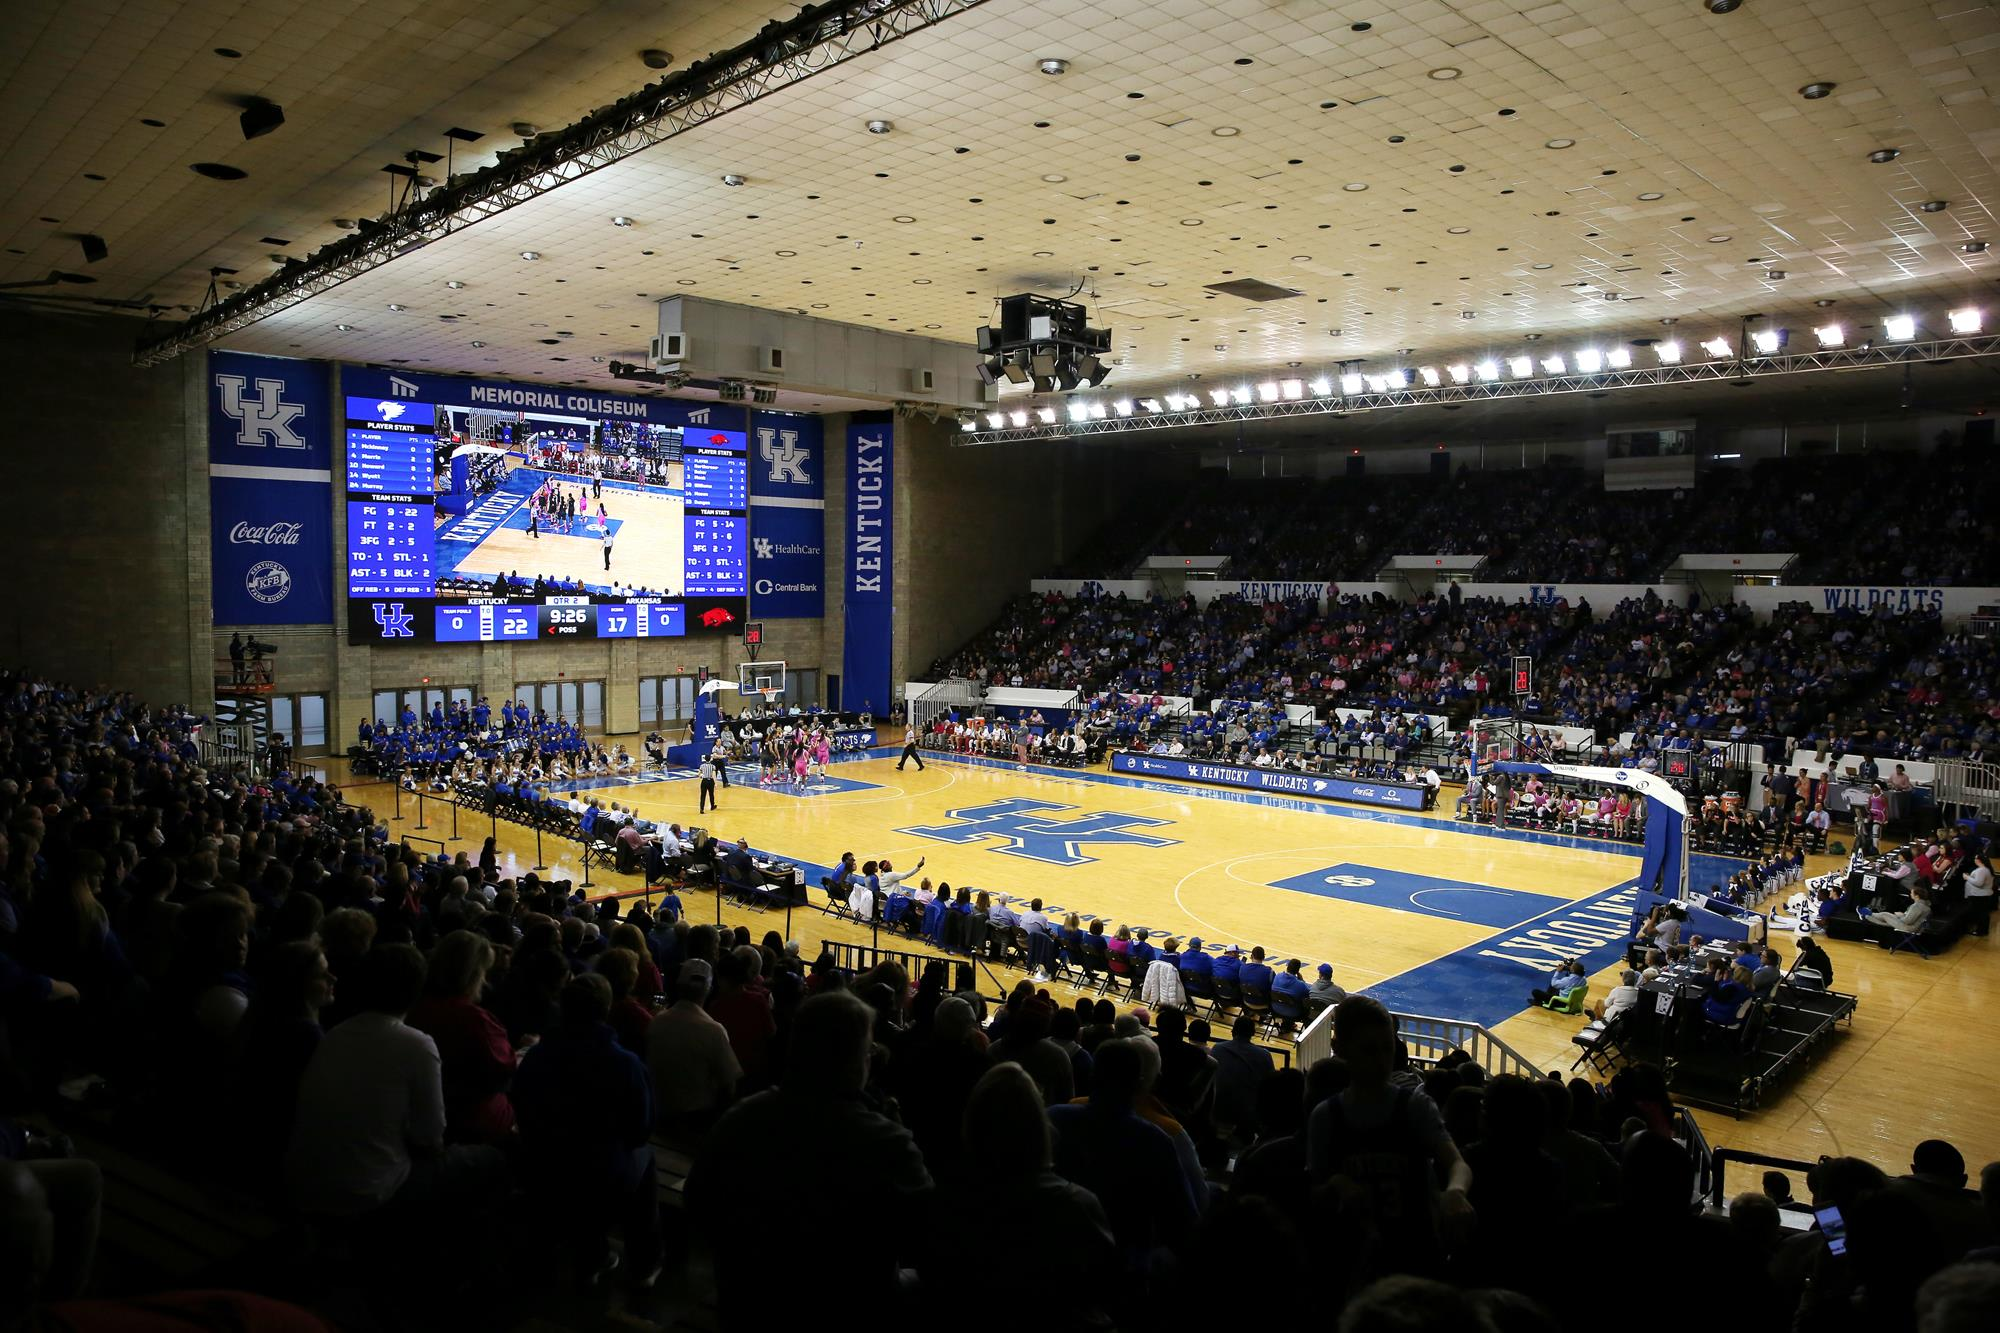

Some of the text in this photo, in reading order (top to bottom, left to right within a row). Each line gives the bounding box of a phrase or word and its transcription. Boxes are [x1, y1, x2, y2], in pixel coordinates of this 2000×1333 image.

[471, 386, 647, 417] MEMORIAL COLISEUM
[216, 373, 305, 449] UK
[367, 422, 415, 432] PLAYER STATS
[757, 426, 811, 485] UK
[363, 507, 418, 517] FG 9 22
[440, 490, 525, 543] KENTUCKY
[856, 436, 883, 592] KENTUCKY
[363, 521, 415, 531] FT 2 2
[712, 520, 718, 528] 5
[230, 521, 303, 545] Coca-Cola
[712, 532, 718, 540] 5
[360, 536, 415, 546] 3FG 2 5
[727, 545, 733, 553] 7
[753, 537, 821, 559] UK HealthCare
[377, 553, 383, 561] 1
[422, 553, 429, 562] 1
[251, 562, 283, 575] KENTUCKY
[380, 568, 387, 577] 5
[423, 569, 430, 578] 2
[259, 576, 280, 588] KFB
[775, 583, 799, 592] Central
[800, 583, 817, 592] Bank
[250, 585, 289, 602] FARM BUREAU
[1240, 583, 1324, 601] KENTUCKY
[553, 597, 579, 605] QTR 2
[625, 597, 662, 605] ARKANSAS
[373, 604, 413, 637] UK
[550, 609, 587, 623] 9:26
[660, 614, 670, 626] 0
[452, 617, 464, 630] 0
[503, 618, 528, 635] 22
[558, 626, 577, 634] POSS
[608, 617, 628, 632] 17
[747, 631, 759, 643] 28
[1188, 764, 1249, 783] UK KENTUCKY
[1261, 773, 1308, 791] WILDCATS
[1799, 899, 1811, 933] CATS
